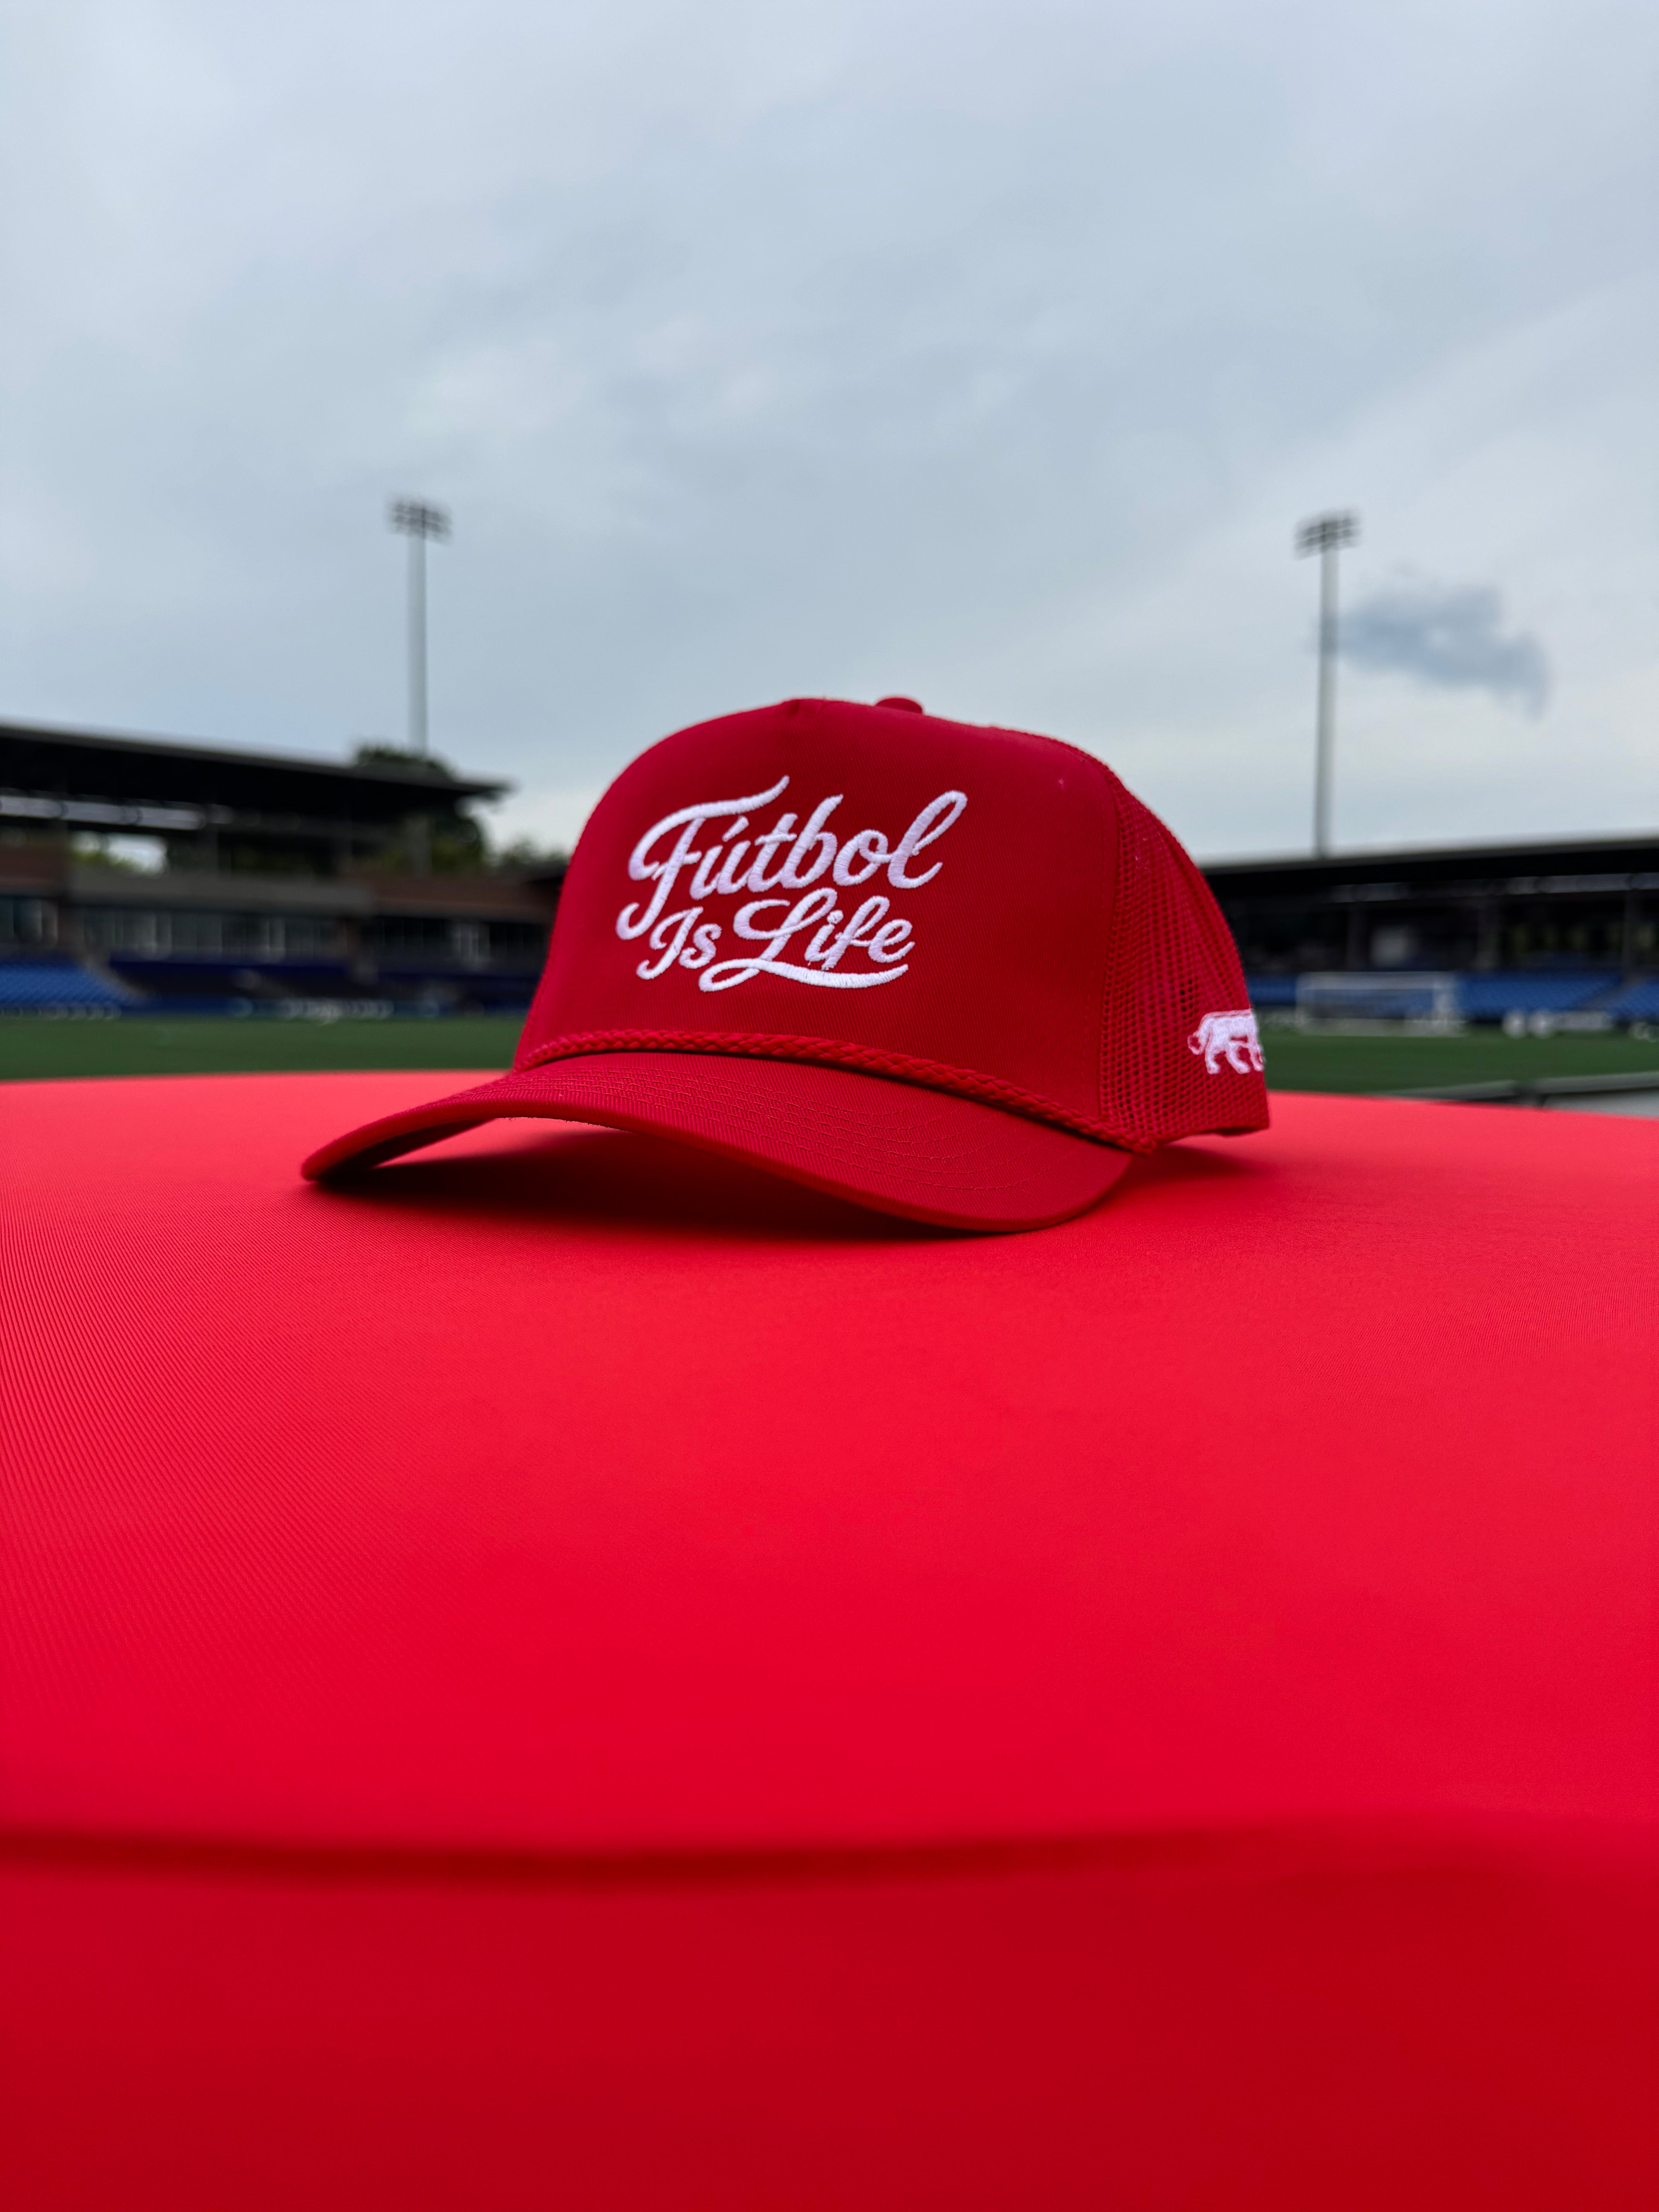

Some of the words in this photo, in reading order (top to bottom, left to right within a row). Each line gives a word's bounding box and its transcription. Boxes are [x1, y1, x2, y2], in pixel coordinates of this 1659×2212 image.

[617, 775, 968, 940] Fútbol
[636, 907, 722, 980] Is
[698, 887, 915, 992] Life
